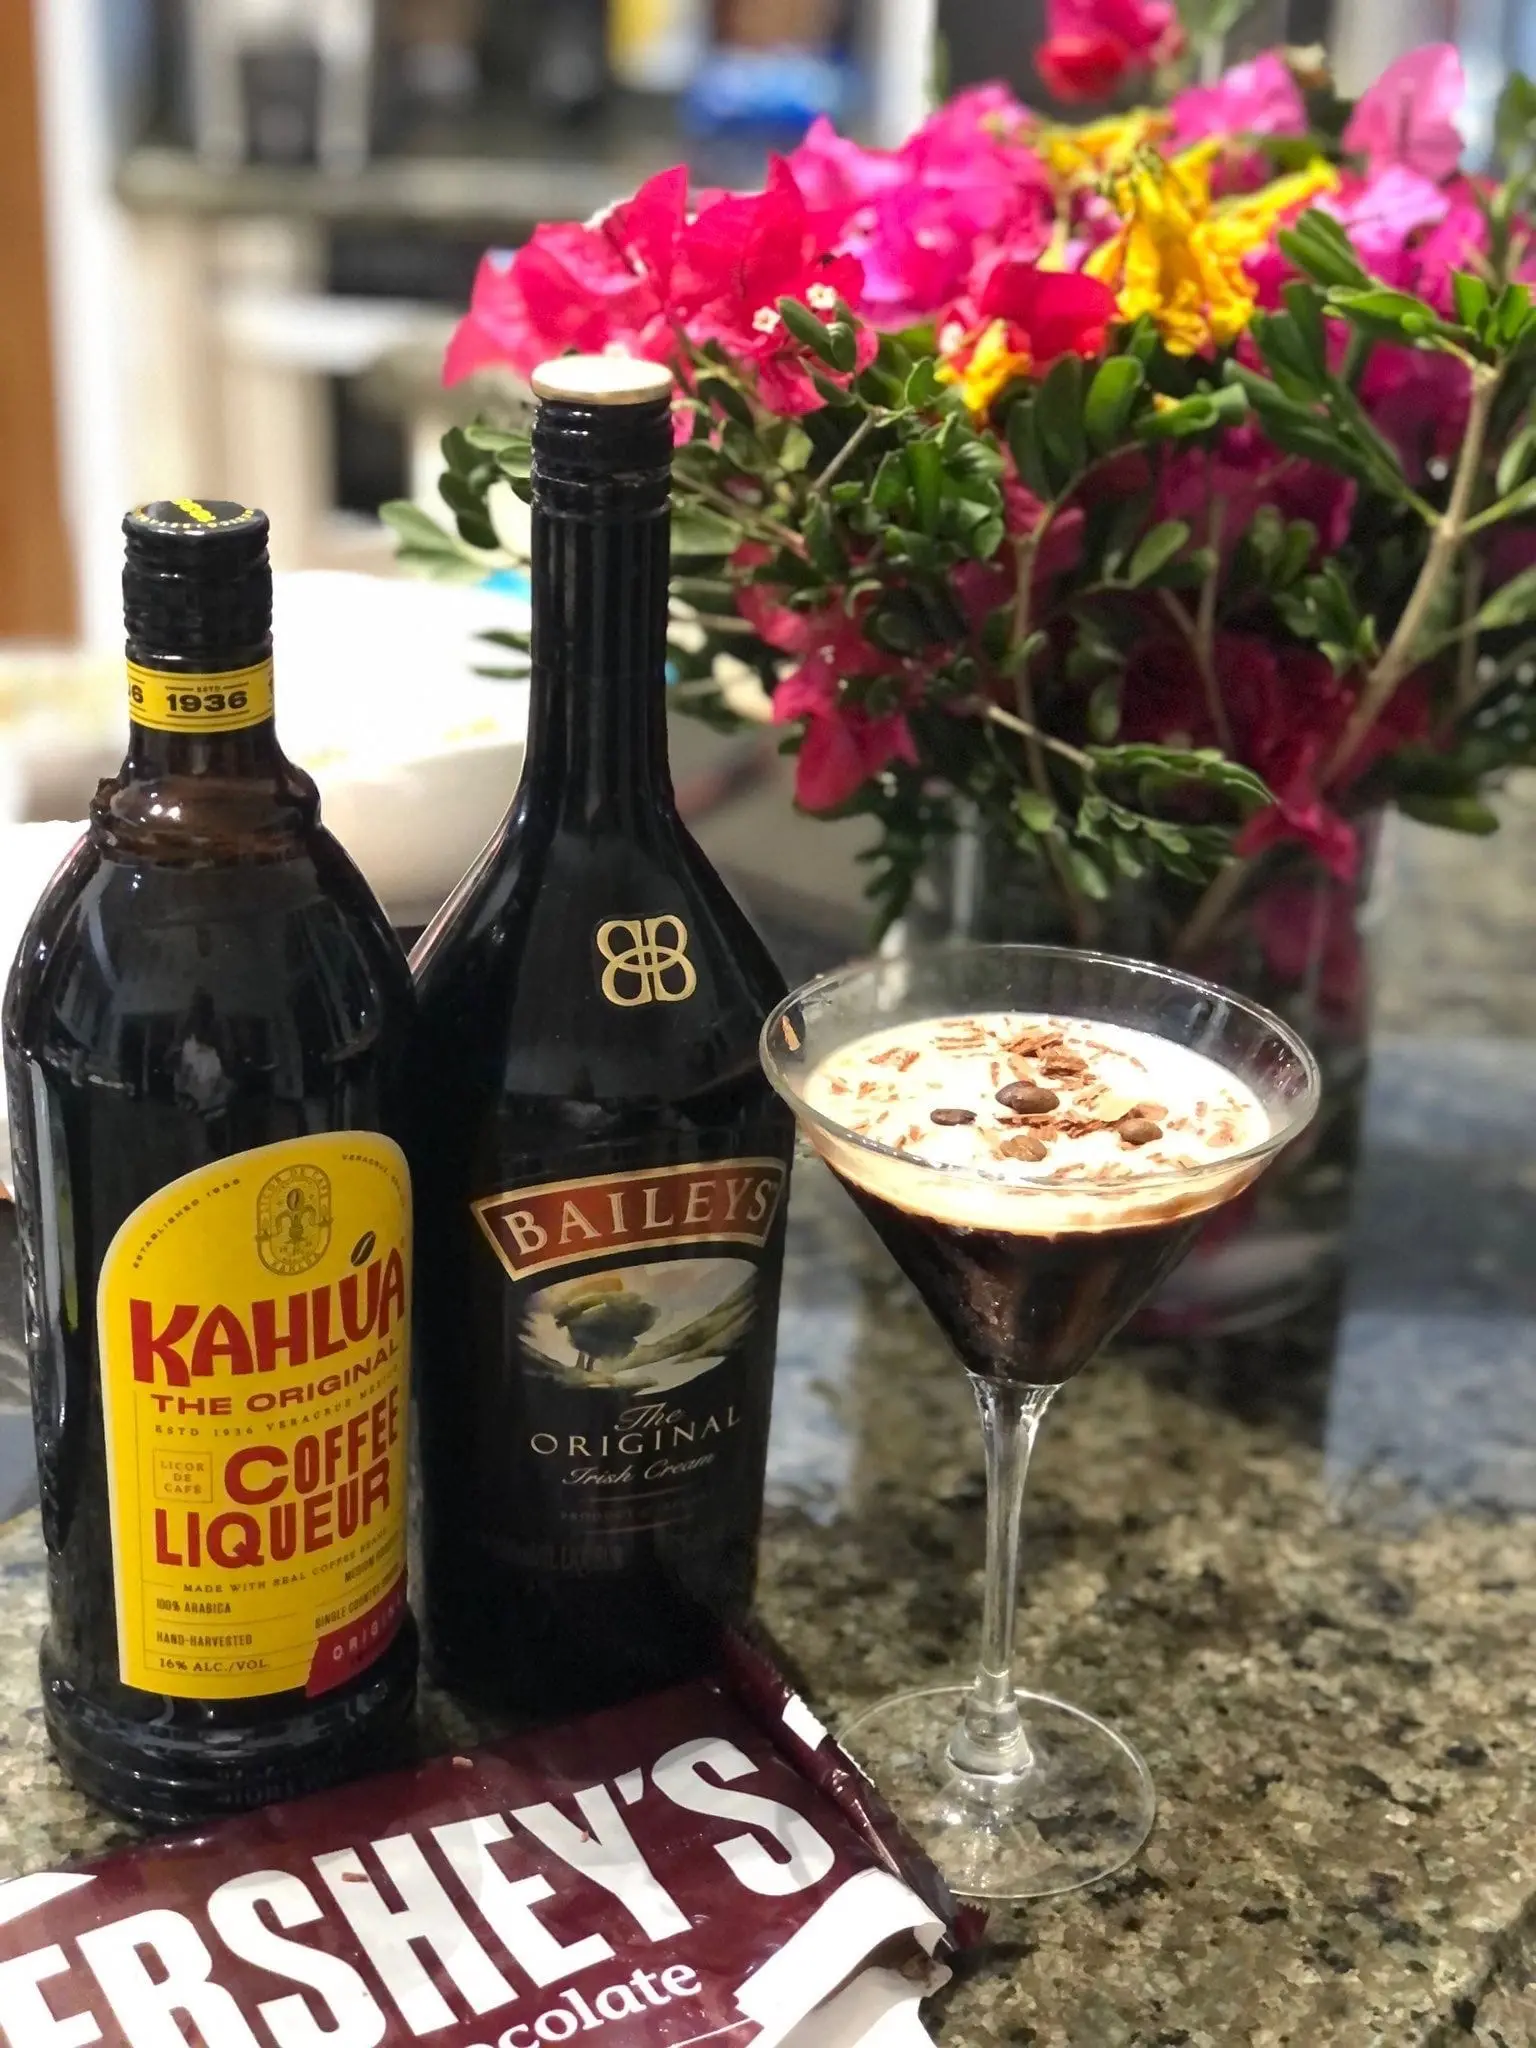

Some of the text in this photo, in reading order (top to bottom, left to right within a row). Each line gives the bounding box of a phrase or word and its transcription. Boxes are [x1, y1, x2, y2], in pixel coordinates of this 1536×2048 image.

[165, 690, 248, 713] 1936
[502, 1177, 776, 1256] BAILEYS
[150, 1338, 398, 1416] THE ORIGINAL
[155, 1424, 200, 1437] ESTD
[214, 1425, 254, 1438] 1936
[530, 1405, 741, 1457] ORIGINAL
[614, 1401, 684, 1432] The
[224, 1386, 398, 1505] COFFEE
[160, 1459, 205, 1473] LICOR
[173, 1472, 192, 1483] DE
[562, 1453, 715, 1485] Irish Cream
[155, 1456, 391, 1569] LIQUEUR
[183, 1583, 223, 1593] MADE
[230, 1581, 266, 1593] WITH
[273, 1572, 307, 1587] REAL
[311, 1549, 356, 1576] COFFEE
[156, 1598, 232, 1615] 100% ARABICA
[315, 1605, 347, 1630] SINGLE
[156, 1630, 253, 1648] HAND-HARVESTED
[160, 1657, 188, 1671] 16%
[465, 1964, 702, 2048] colate
